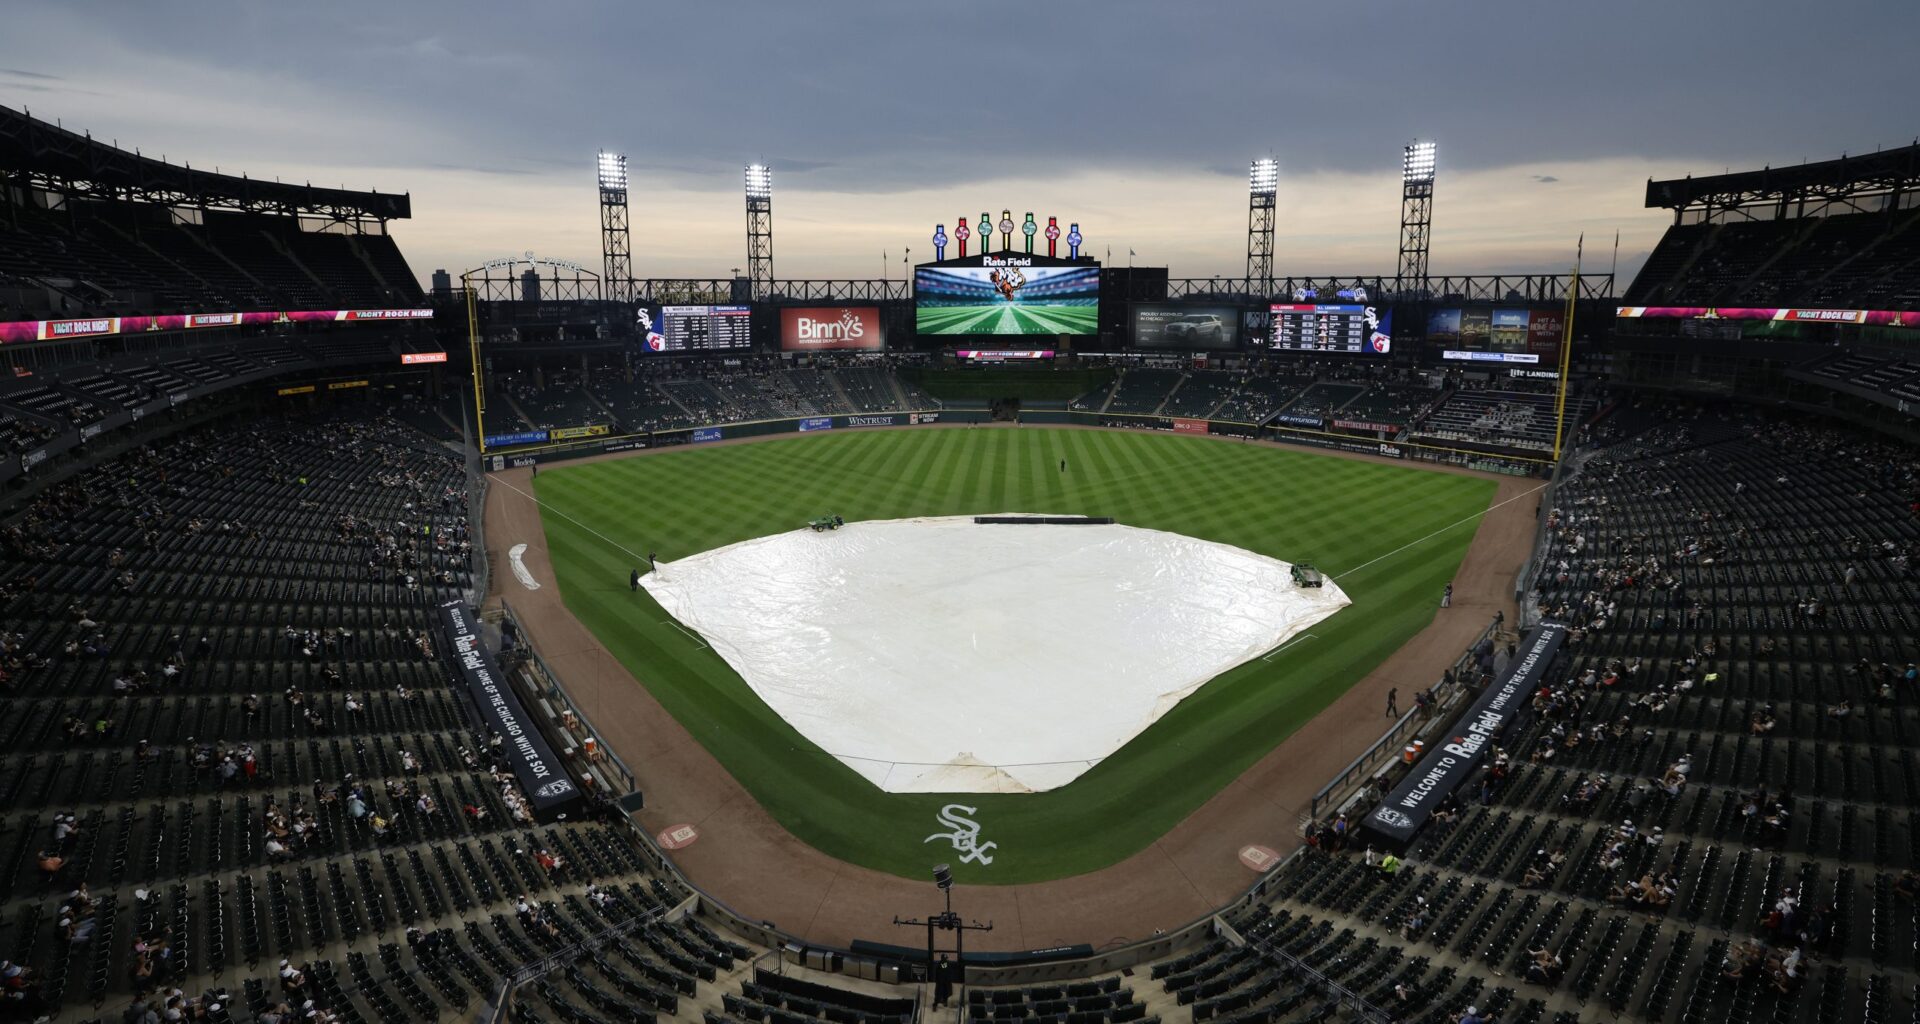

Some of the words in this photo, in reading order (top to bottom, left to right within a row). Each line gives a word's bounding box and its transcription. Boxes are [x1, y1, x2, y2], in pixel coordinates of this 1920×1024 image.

[483, 257, 517, 272] KIDS
[545, 257, 581, 272] ZONE
[983, 256, 1006, 266] Rate
[1007, 257, 1031, 266] Field
[656, 292, 730, 304] SPORTSBOOK
[1797, 310, 1819, 319] YACHT
[1820, 311, 1842, 320] ROCK
[53, 322, 73, 334] YACHT
[74, 321, 91, 333] ROCK
[848, 416, 892, 425] WINTRUST
[1380, 444, 1400, 454] Rate
[513, 458, 535, 467] Modelo
[450, 607, 465, 628] WELCOME
[461, 649, 485, 670] Field
[1543, 630, 1554, 640] SOX
[1531, 635, 1549, 656] WHITE
[1517, 654, 1540, 676] CHICAGO
[476, 668, 492, 687] HOME
[1509, 669, 1526, 685] THE
[485, 685, 497, 695] OF
[1505, 682, 1516, 695] OF
[490, 692, 504, 707] THE
[1489, 691, 1510, 711] HOME
[496, 705, 522, 736] CHICAGO
[1469, 711, 1503, 736] Field
[514, 730, 539, 761] WHITE
[1444, 731, 1486, 758] Rate
[530, 758, 550, 779] SOX
[1438, 756, 1456, 771] TO
[1400, 770, 1443, 808] WELCOME
